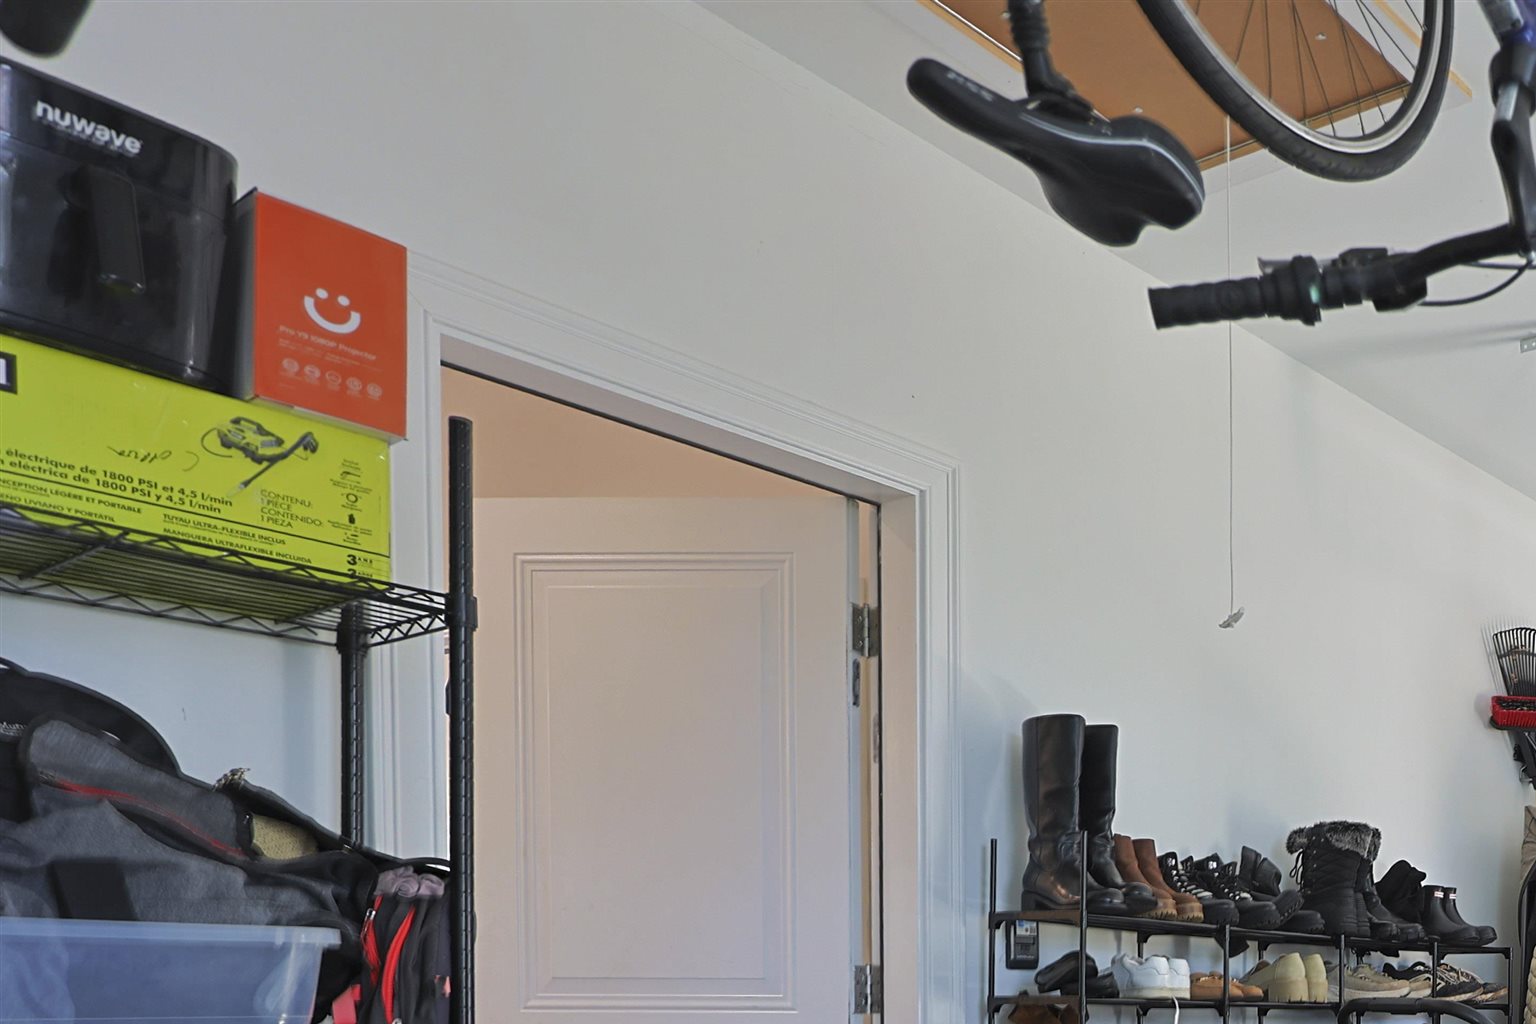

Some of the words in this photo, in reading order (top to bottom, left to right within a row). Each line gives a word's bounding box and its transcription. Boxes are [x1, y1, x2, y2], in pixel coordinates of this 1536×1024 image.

[36, 100, 142, 154] nuwave
[338, 343, 377, 361] Projector
[73, 474, 90, 484] de
[96, 478, 127, 492] 1800
[131, 486, 151, 498] PSI
[155, 494, 162, 502] y
[189, 499, 221, 514] l/min
[80, 465, 96, 476] de
[103, 470, 134, 484] 1800
[138, 478, 158, 490] PSI
[162, 486, 174, 494] et
[201, 492, 233, 507] l/min
[86, 496, 95, 504] ET
[97, 500, 142, 514] PORTABLE
[163, 513, 191, 525] TUYAU
[258, 535, 286, 546] INCLUS
[266, 515, 293, 529] PIEZA
[163, 527, 213, 544] MANGUERA
[275, 551, 312, 565] INCLUIDA
[347, 554, 358, 566] 3
